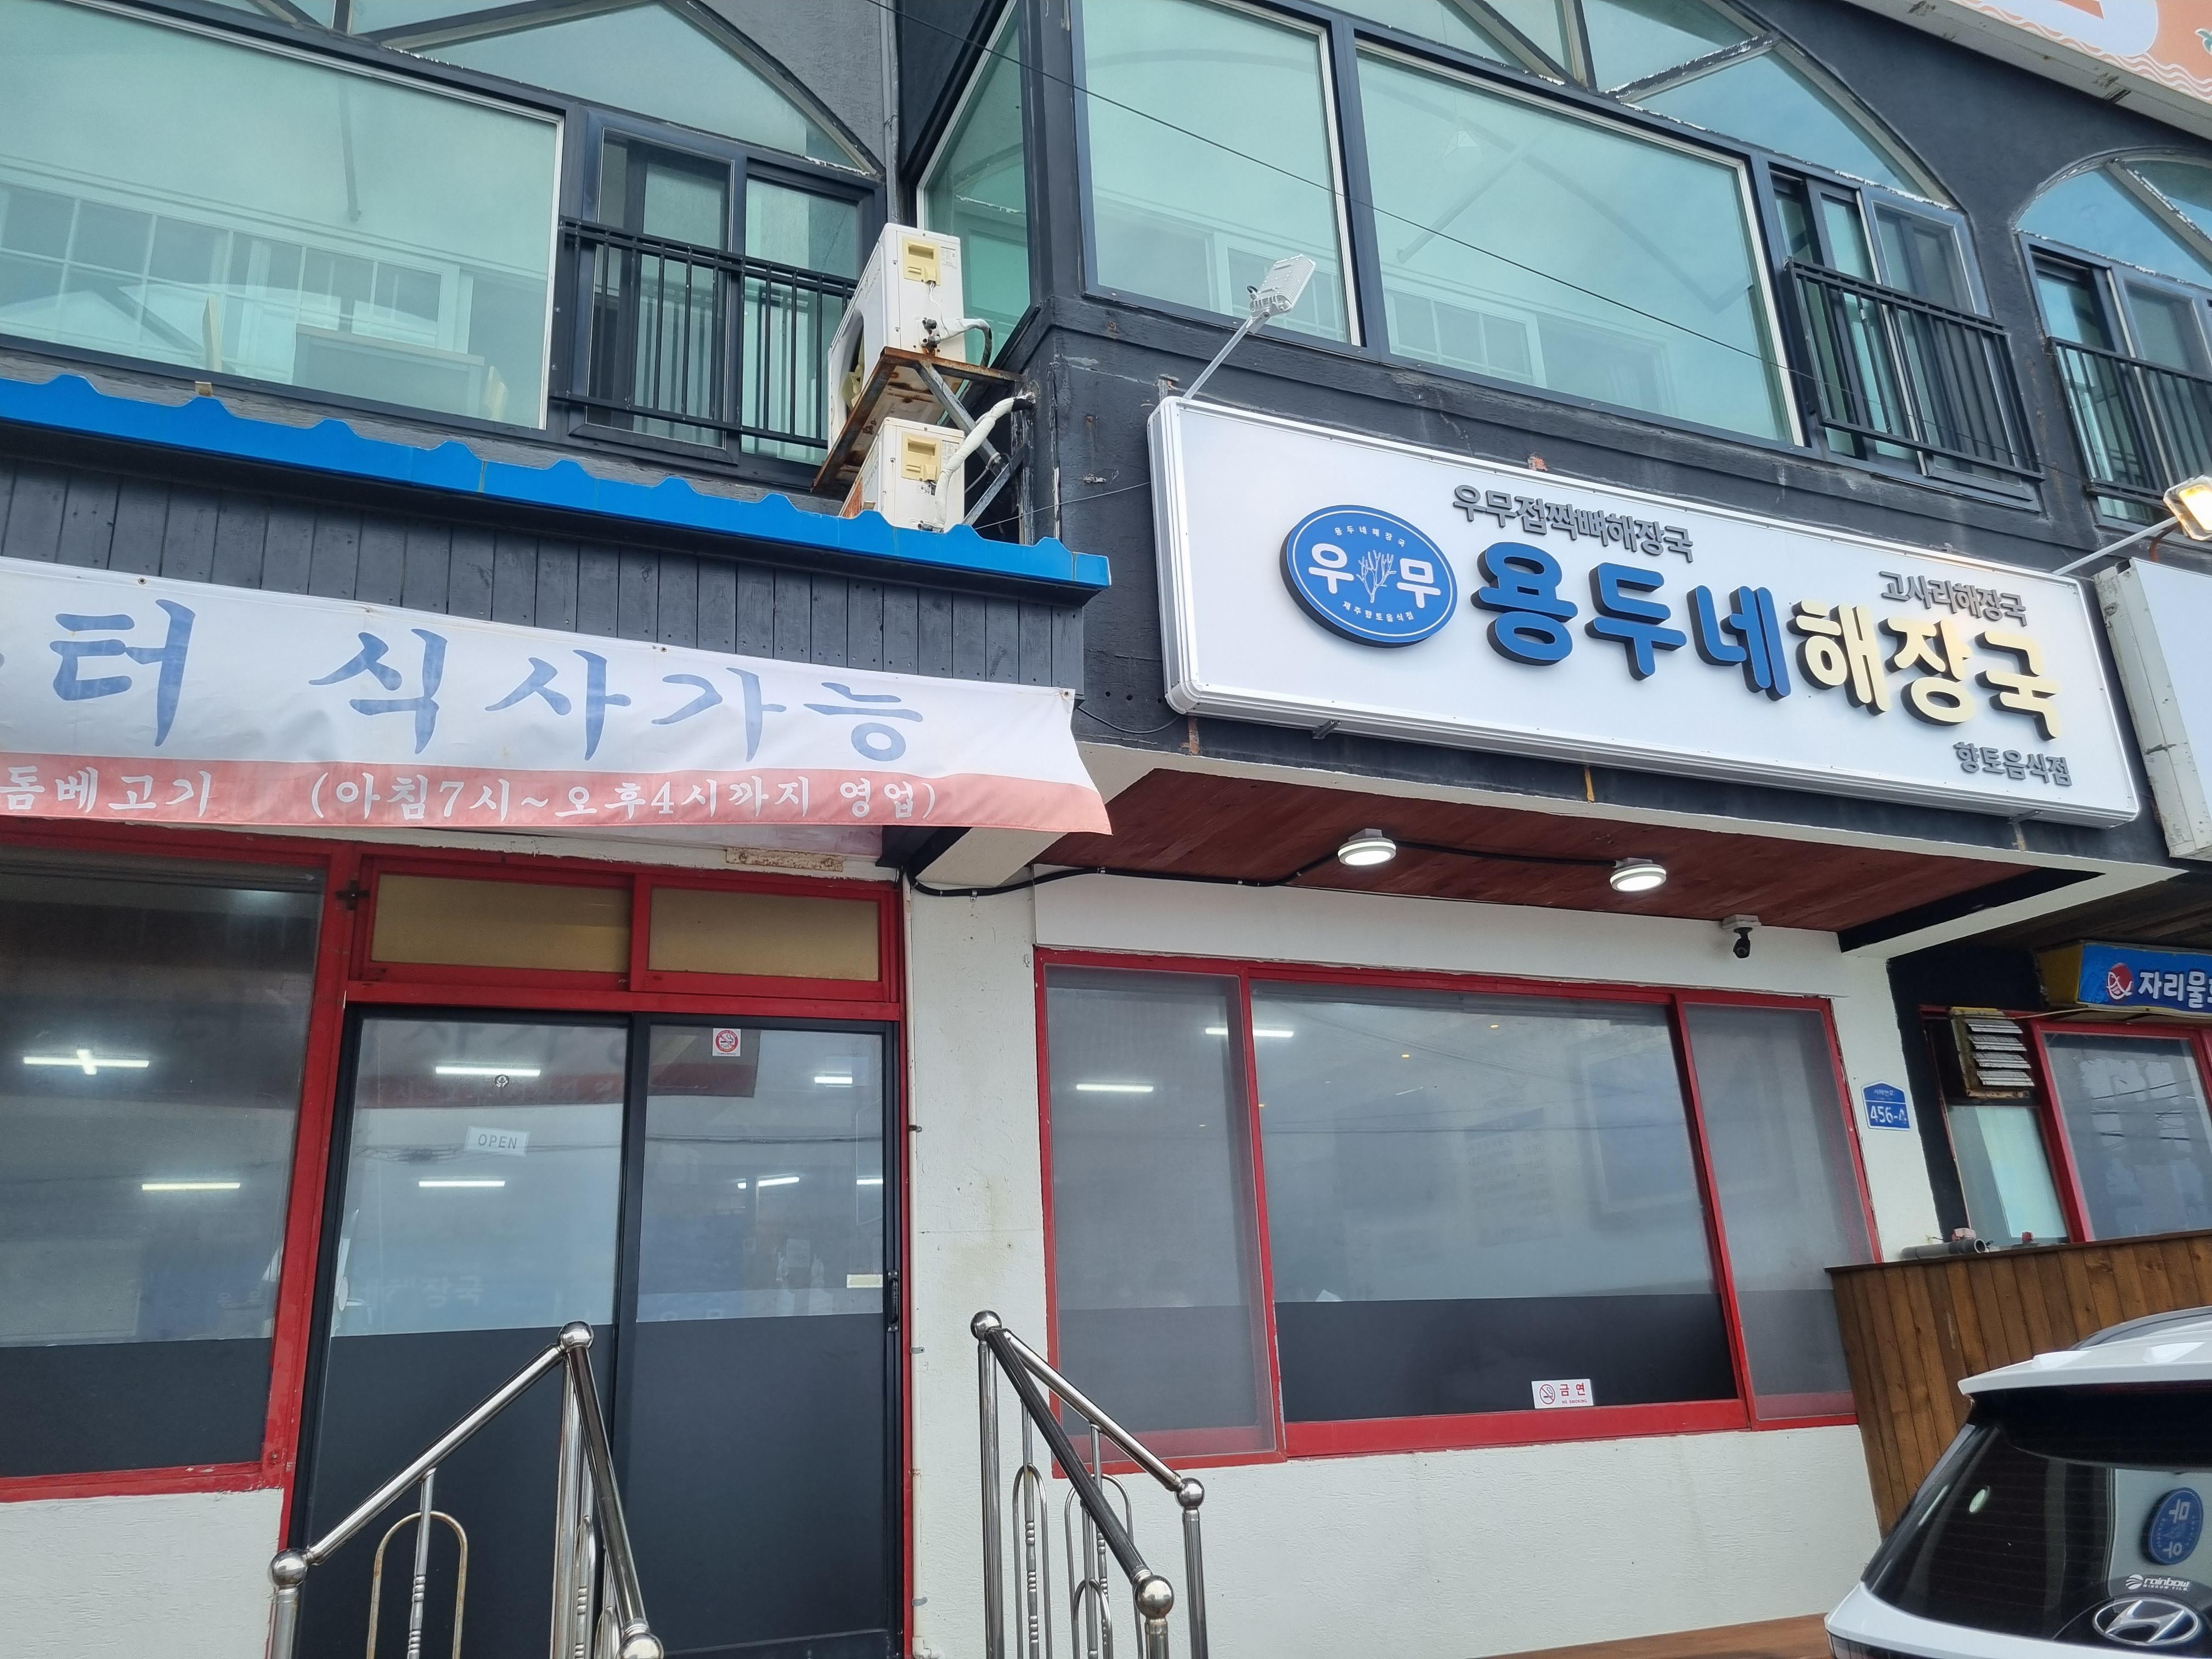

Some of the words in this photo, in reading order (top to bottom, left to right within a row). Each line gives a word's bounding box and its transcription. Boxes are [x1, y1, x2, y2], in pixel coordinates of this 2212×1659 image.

[1334, 526, 1405, 548] 용두네해장국
[1453, 484, 1694, 562] 우무접짝뼈해장국
[1308, 543, 1355, 595] 우
[1396, 557, 1441, 609] 무
[1342, 601, 1414, 623] 제주향토음식점
[1878, 571, 2028, 627] 고사리해장국
[1953, 741, 2073, 786] 향토음식점
[0, 765, 212, 818] 돔베고기
[840, 777, 936, 820] 영업)
[2138, 972, 2212, 1008] 자리물
[478, 1133, 517, 1149] OPEN
[2144, 1577, 2191, 1587] rainbow
